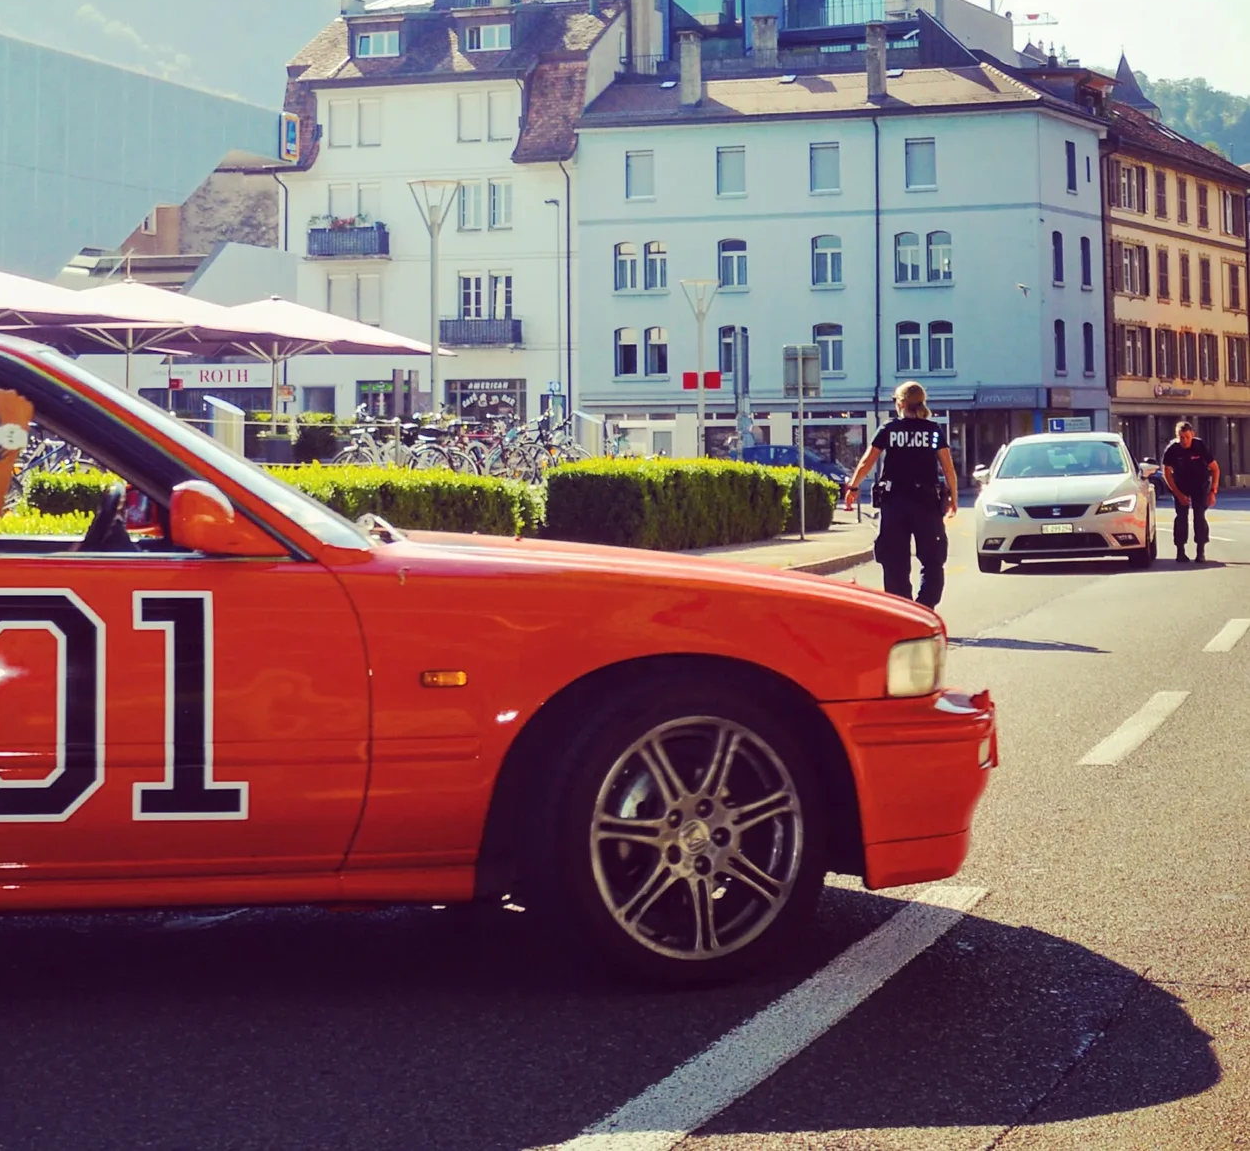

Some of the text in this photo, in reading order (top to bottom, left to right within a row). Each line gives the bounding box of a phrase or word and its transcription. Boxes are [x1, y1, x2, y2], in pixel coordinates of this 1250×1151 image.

[200, 369, 248, 383] ROTH
[468, 381, 509, 390] AMERICAN
[501, 394, 516, 407] BAR
[1053, 420, 1061, 430] L
[890, 431, 929, 447] POLICE
